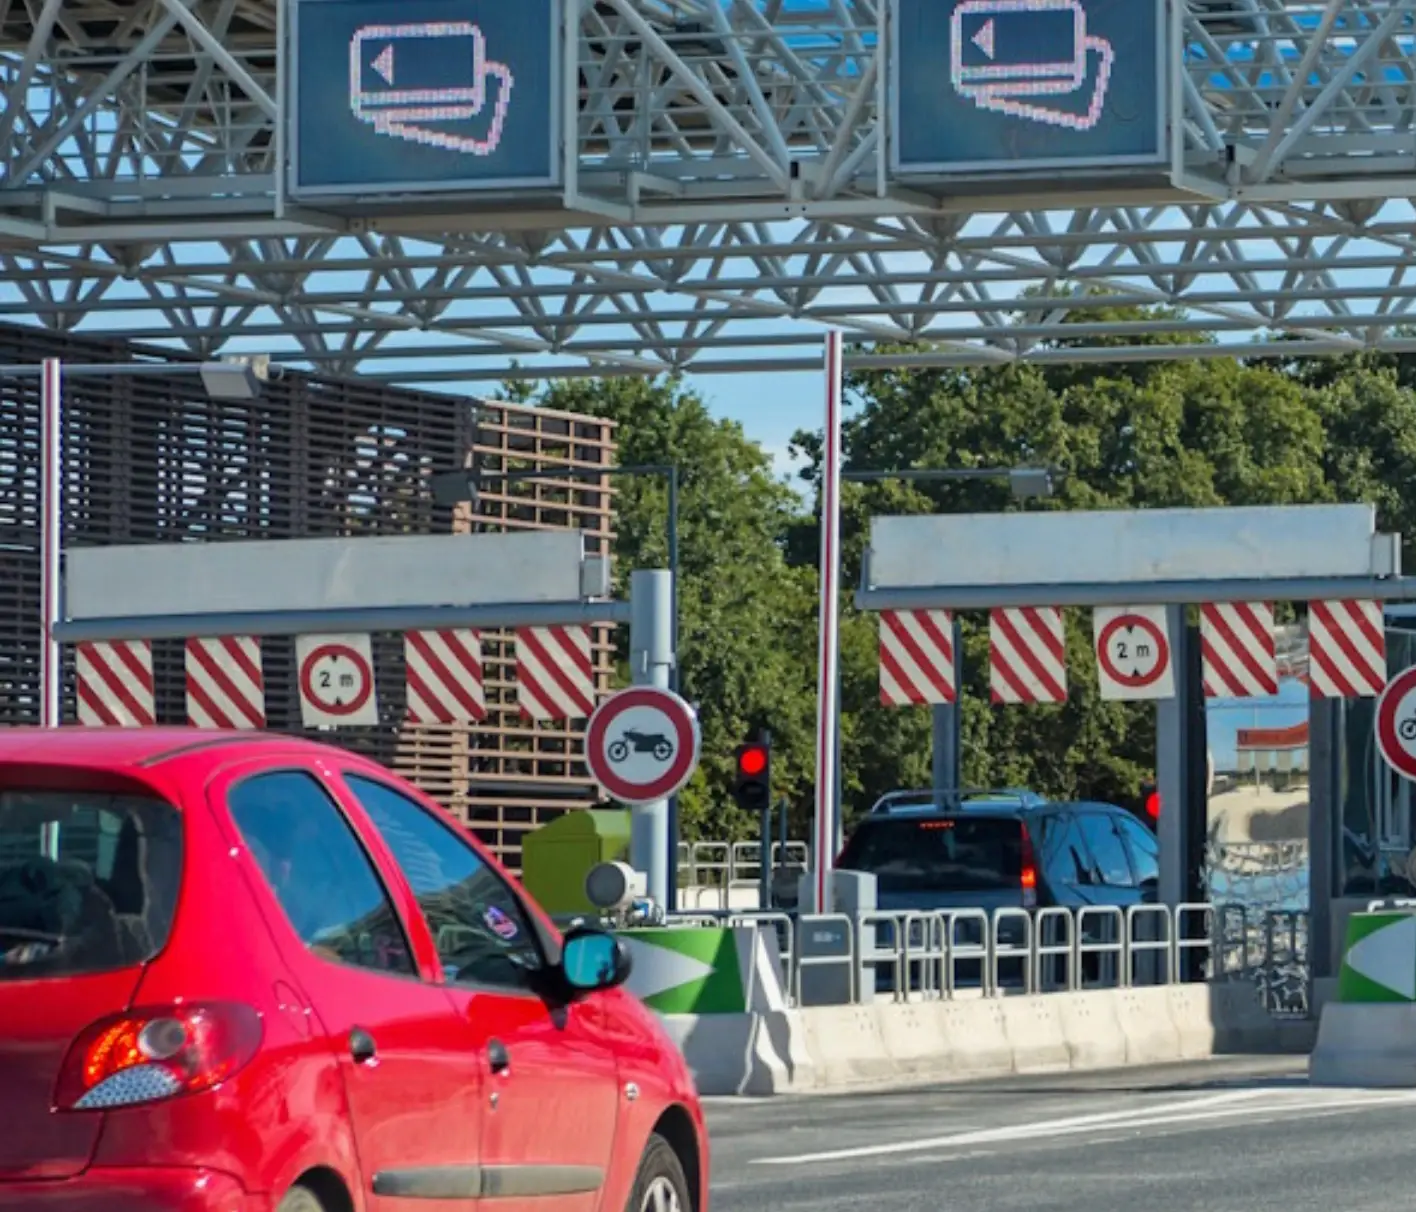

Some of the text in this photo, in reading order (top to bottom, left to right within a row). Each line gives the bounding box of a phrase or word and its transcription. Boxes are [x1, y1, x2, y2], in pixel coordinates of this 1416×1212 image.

[1116, 641, 1150, 659] 2 m
[319, 671, 354, 688] 2 m
